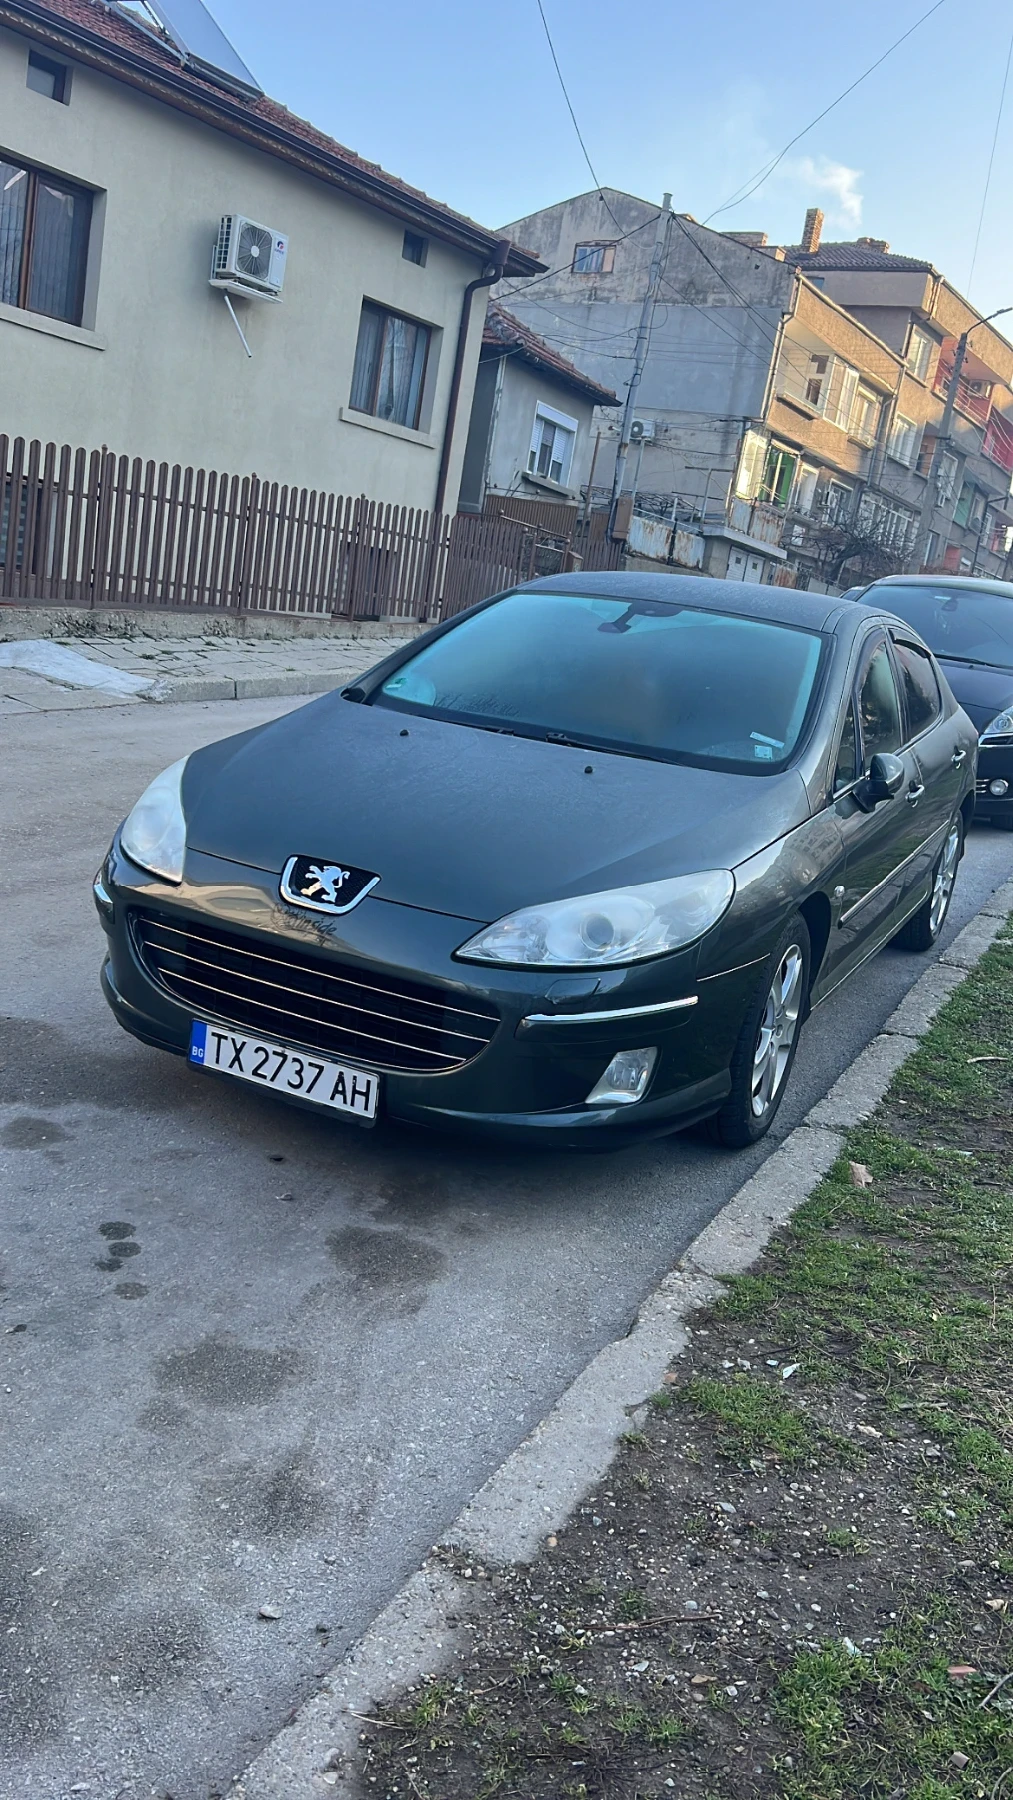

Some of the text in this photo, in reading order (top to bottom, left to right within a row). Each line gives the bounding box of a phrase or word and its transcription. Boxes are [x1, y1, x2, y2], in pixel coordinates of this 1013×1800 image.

[192, 1045, 204, 1058] BG
[211, 1032, 371, 1112] TX 2737 AH
